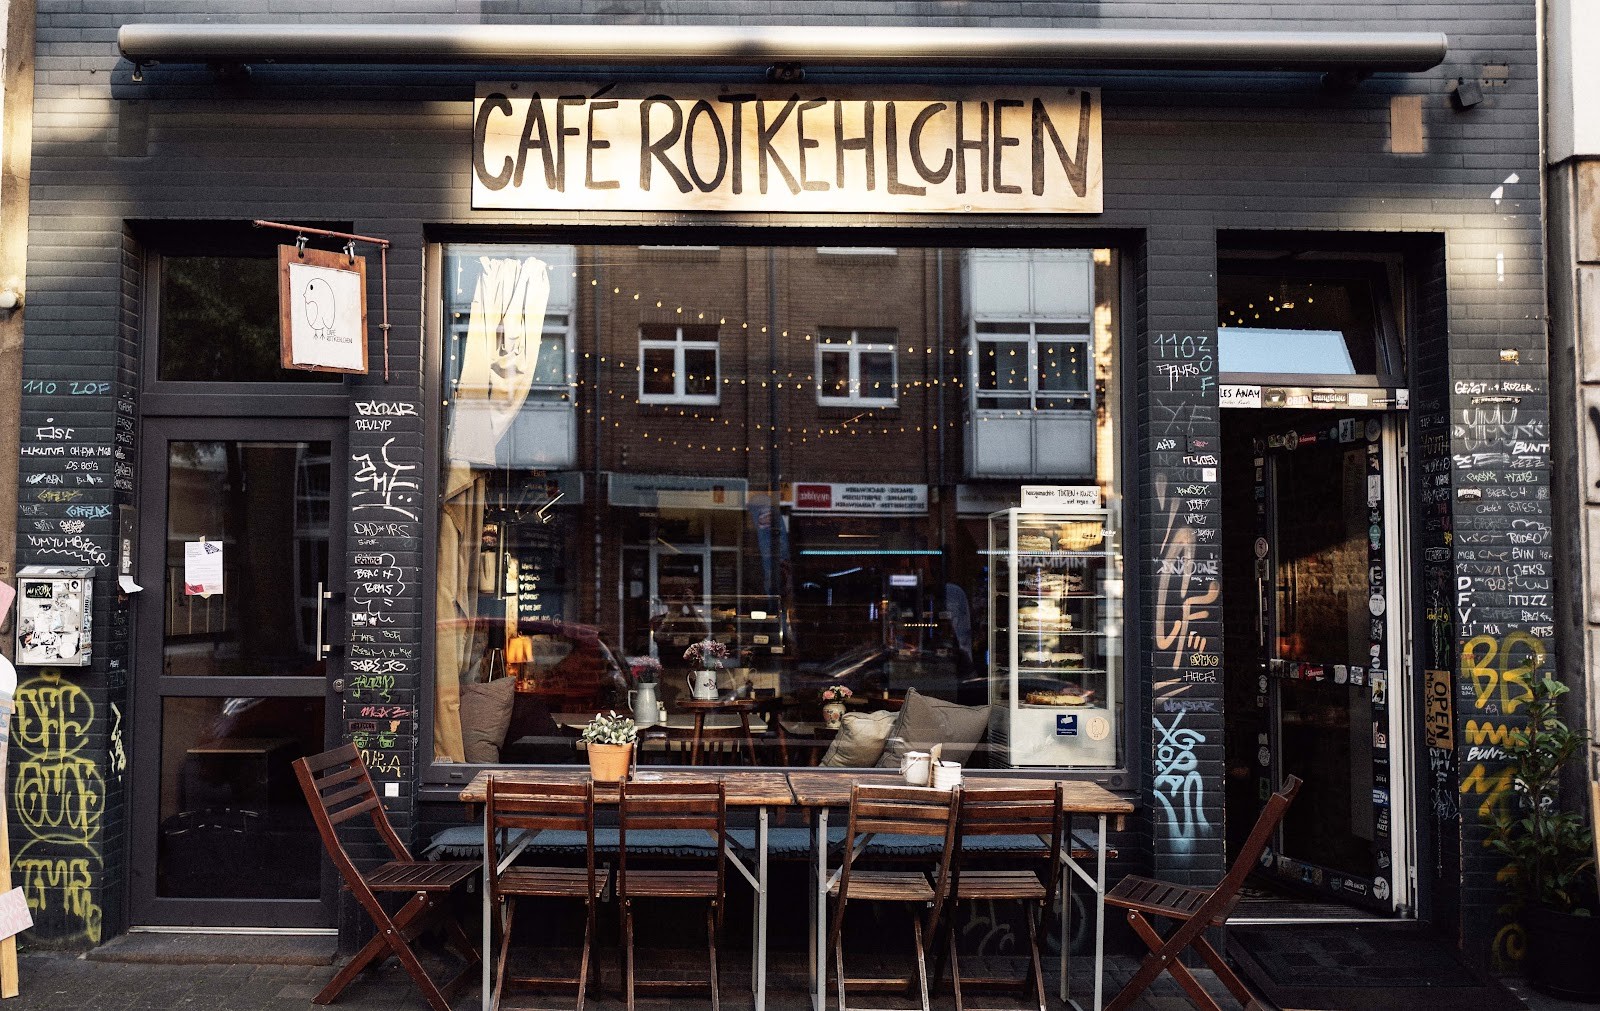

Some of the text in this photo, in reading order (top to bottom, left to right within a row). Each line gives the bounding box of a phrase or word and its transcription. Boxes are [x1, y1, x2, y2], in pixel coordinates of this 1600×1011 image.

[474, 82, 1091, 198] CAFÉ ROTKEHLCHEN
[1154, 334, 1195, 358] 110
[24, 381, 57, 394] 110
[1512, 441, 1550, 455] BUNT
[1434, 681, 1450, 741] OPEN
